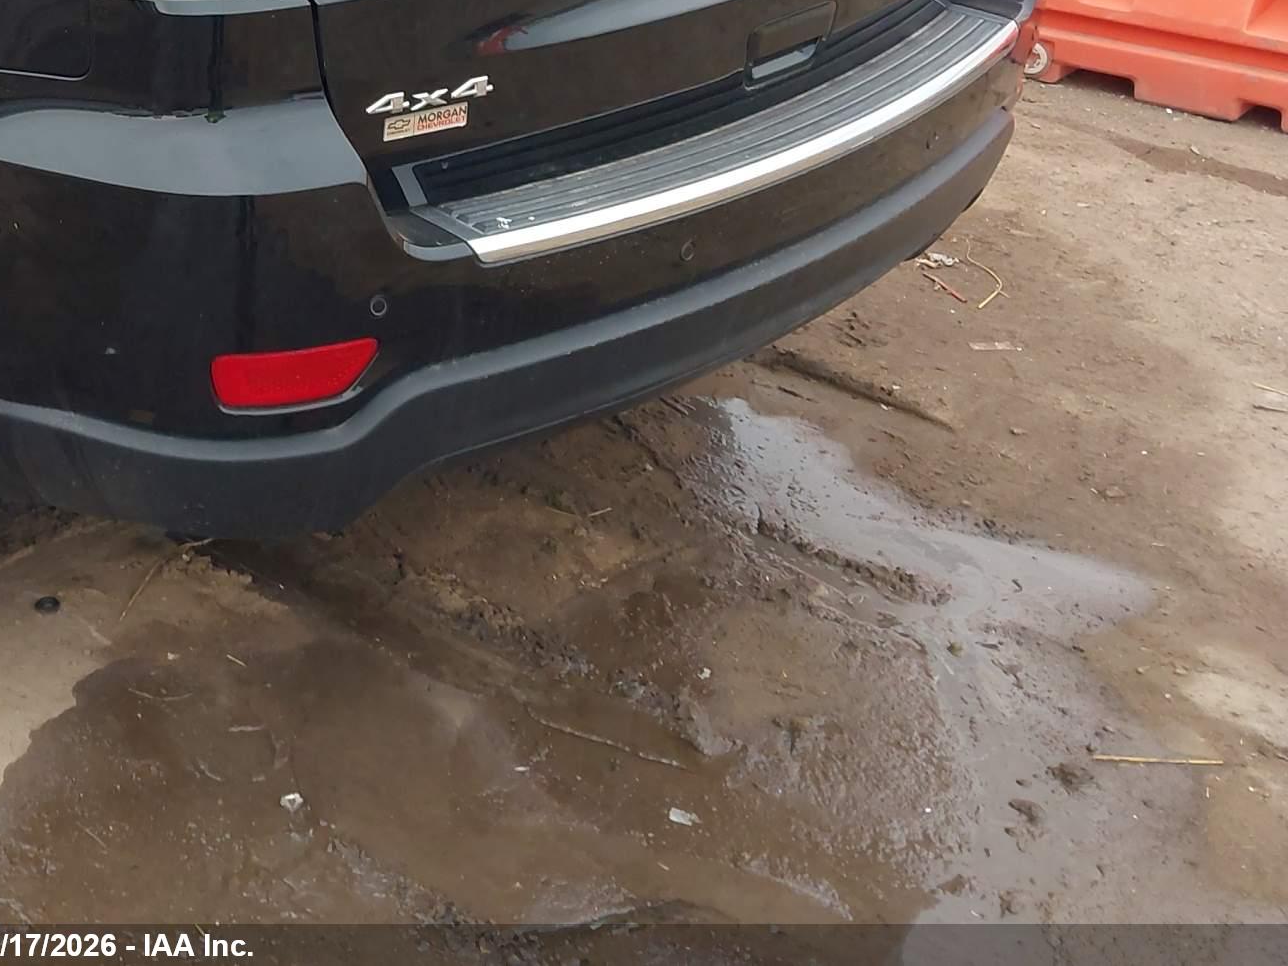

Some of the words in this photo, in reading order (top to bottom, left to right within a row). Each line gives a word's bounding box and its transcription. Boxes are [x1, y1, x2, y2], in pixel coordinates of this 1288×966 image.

[365, 75, 494, 114] 4x4
[416, 115, 466, 131] CHEVROLET
[418, 105, 467, 124] MORGAN
